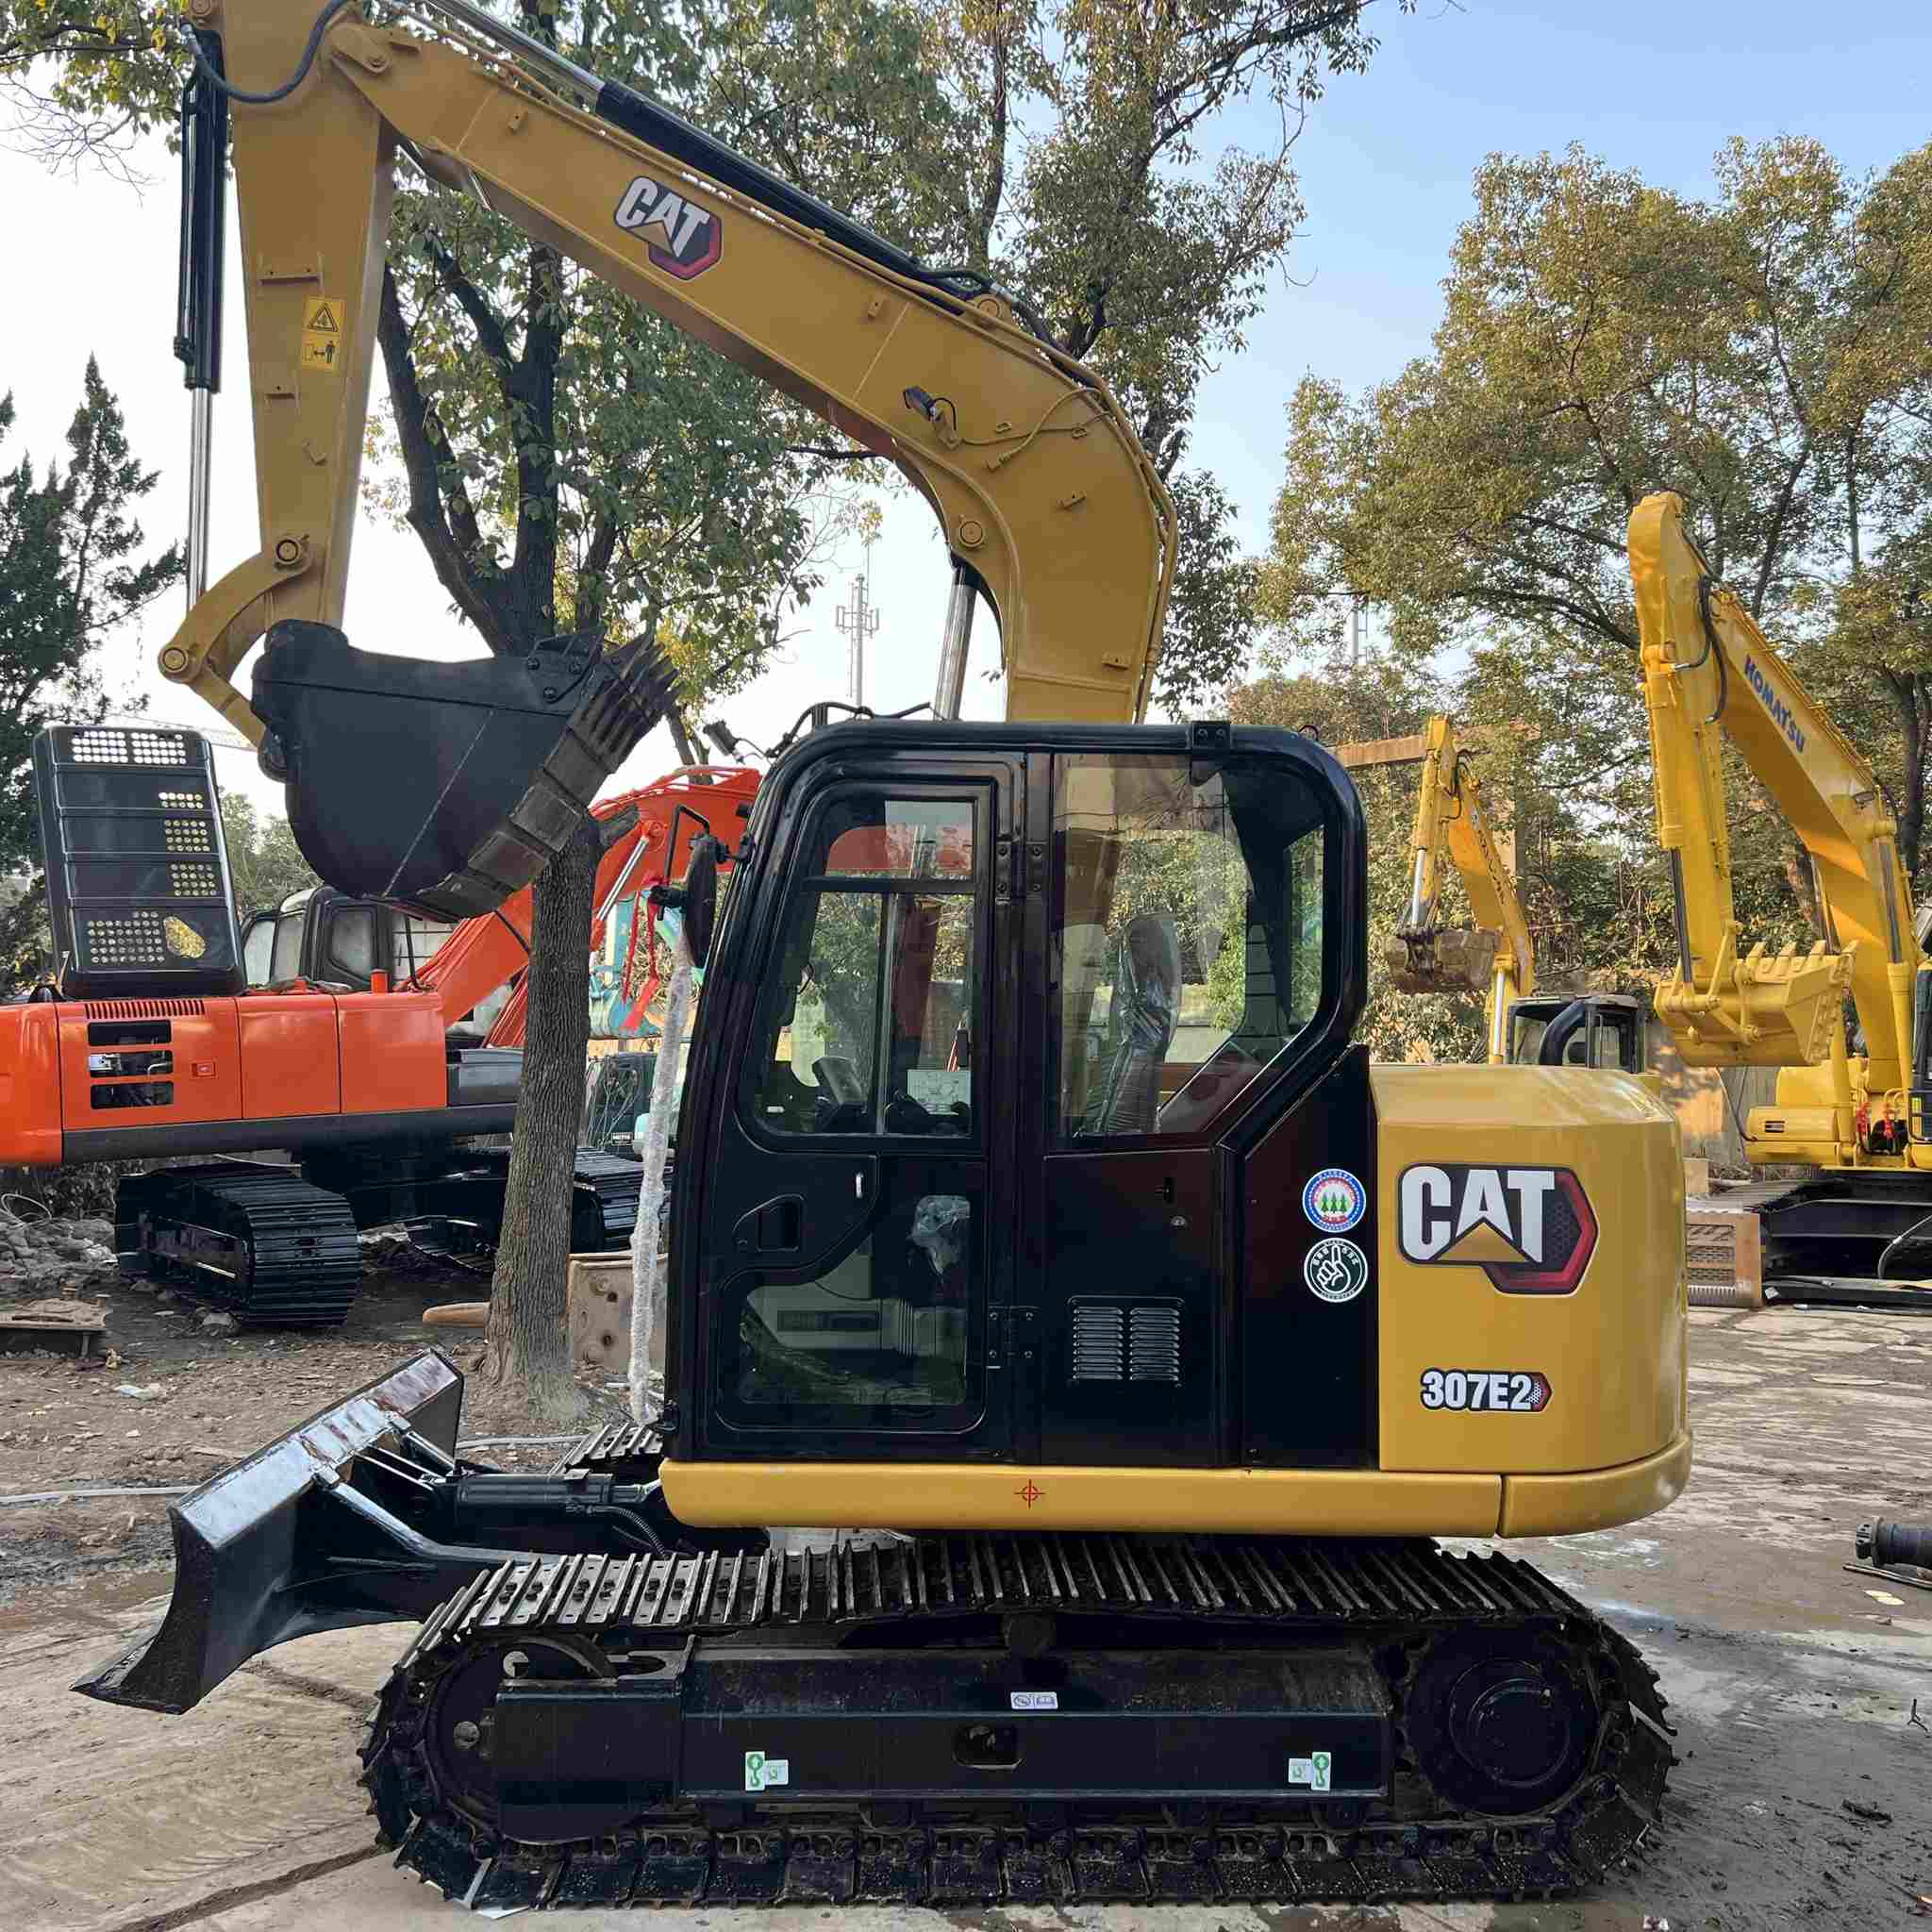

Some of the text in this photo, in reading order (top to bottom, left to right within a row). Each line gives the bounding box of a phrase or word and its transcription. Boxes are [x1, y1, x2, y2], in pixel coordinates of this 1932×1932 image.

[615, 177, 709, 257] CAT
[1744, 654, 1805, 753] KOMATSU
[1402, 1166, 1555, 1263] CAT
[1422, 1371, 1532, 1409] 307E2
